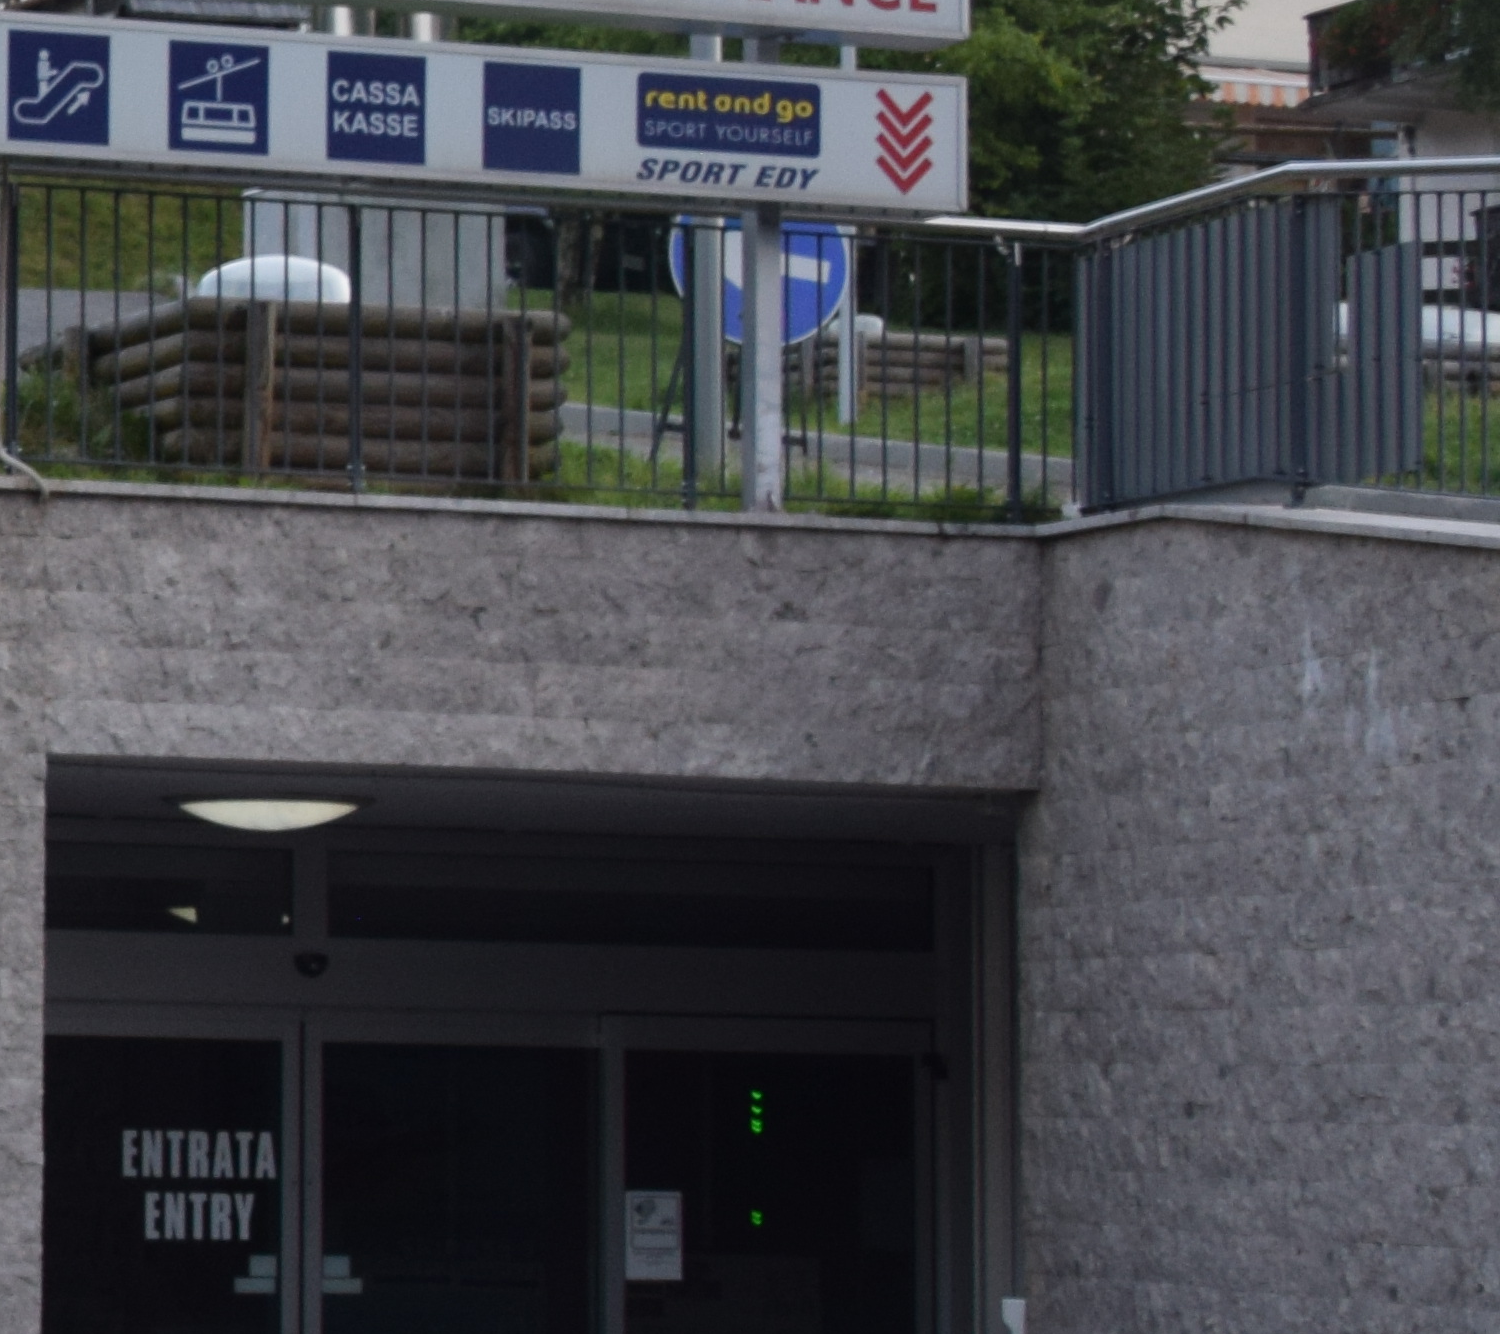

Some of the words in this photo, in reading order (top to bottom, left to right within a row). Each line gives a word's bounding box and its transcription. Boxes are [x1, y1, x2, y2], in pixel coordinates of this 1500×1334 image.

[332, 79, 421, 107] CASSA
[645, 88, 707, 113] rent
[714, 92, 771, 116] and
[776, 99, 815, 124] go
[332, 110, 419, 138] KASSE
[487, 106, 577, 130] SKIPASS
[645, 119, 707, 140] SPORT
[715, 124, 814, 146] YOURSELF
[637, 158, 746, 187] SPORT
[754, 166, 820, 191] EDY
[121, 1128, 278, 1180] ENTRATA
[143, 1191, 257, 1243] ENTRY
